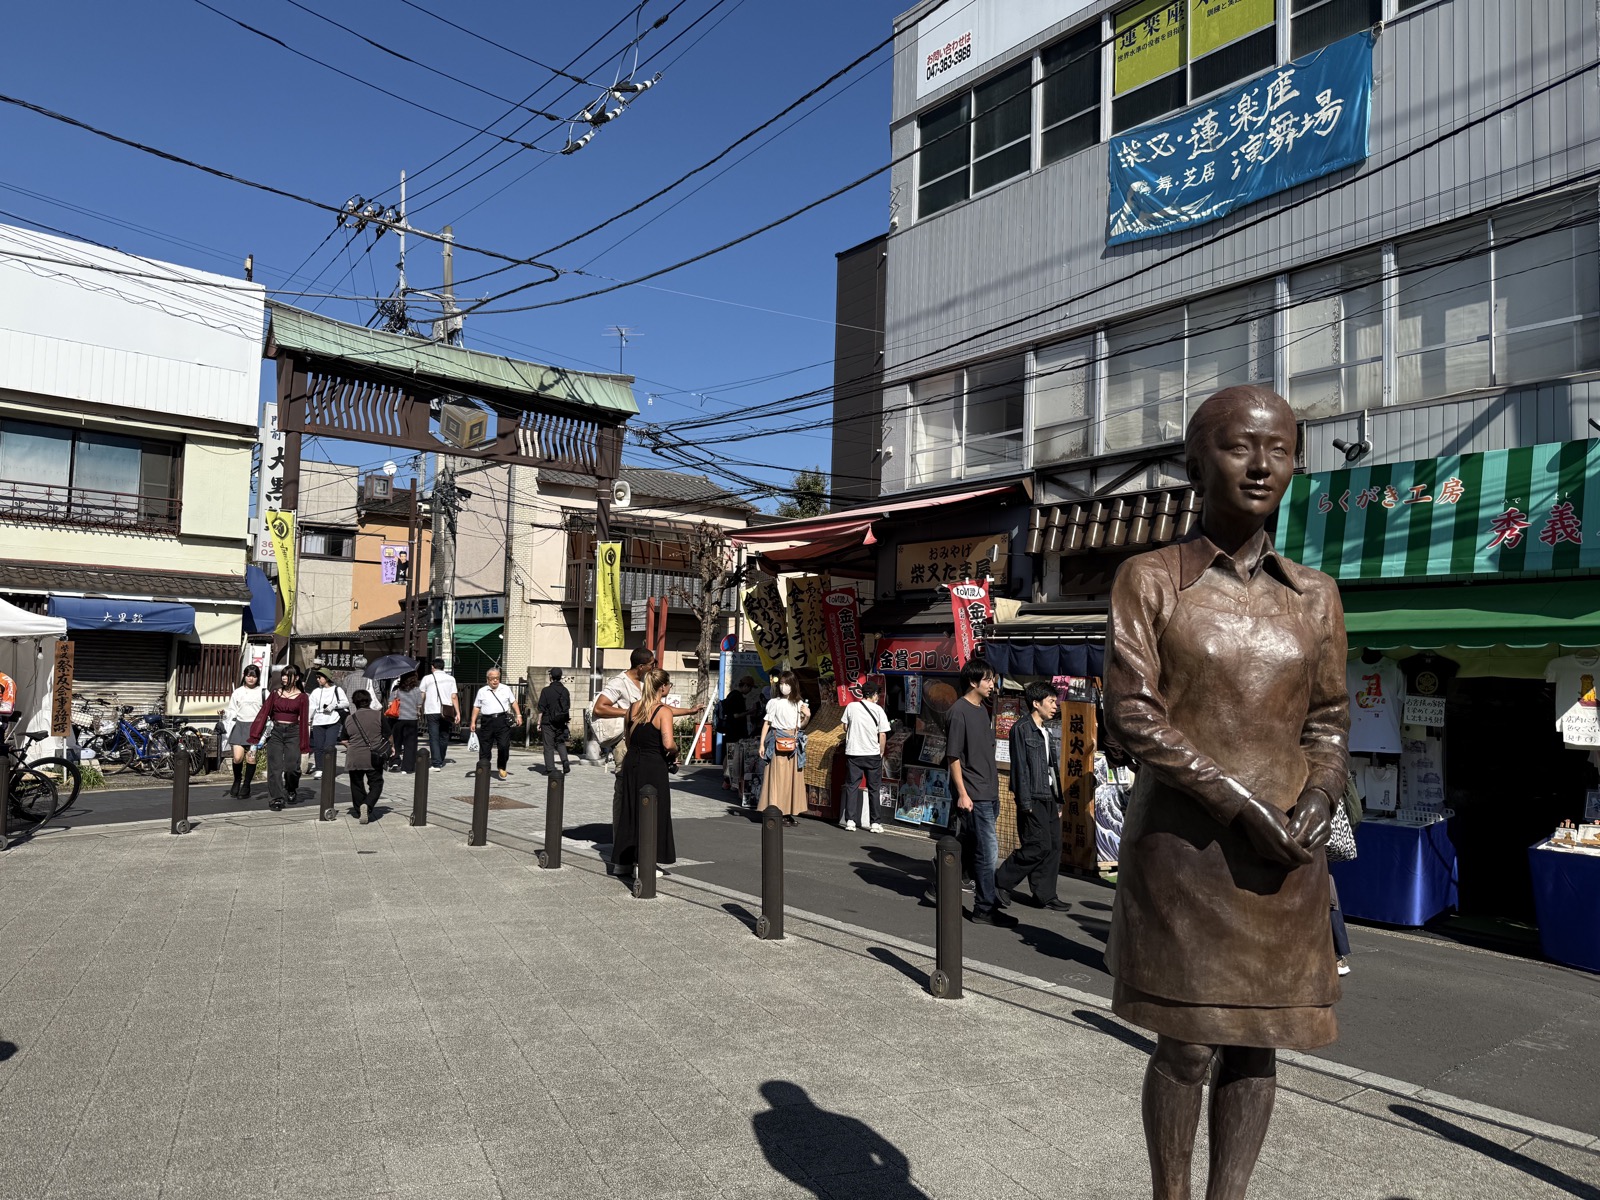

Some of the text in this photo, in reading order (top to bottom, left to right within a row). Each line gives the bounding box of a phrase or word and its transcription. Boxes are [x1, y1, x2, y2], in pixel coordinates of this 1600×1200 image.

[927, 32, 971, 66] お問い合わせは
[1318, 477, 1465, 514] らくがき工房
[929, 543, 972, 560] おみやげ
[1067, 714, 1084, 778] 炭火焼
